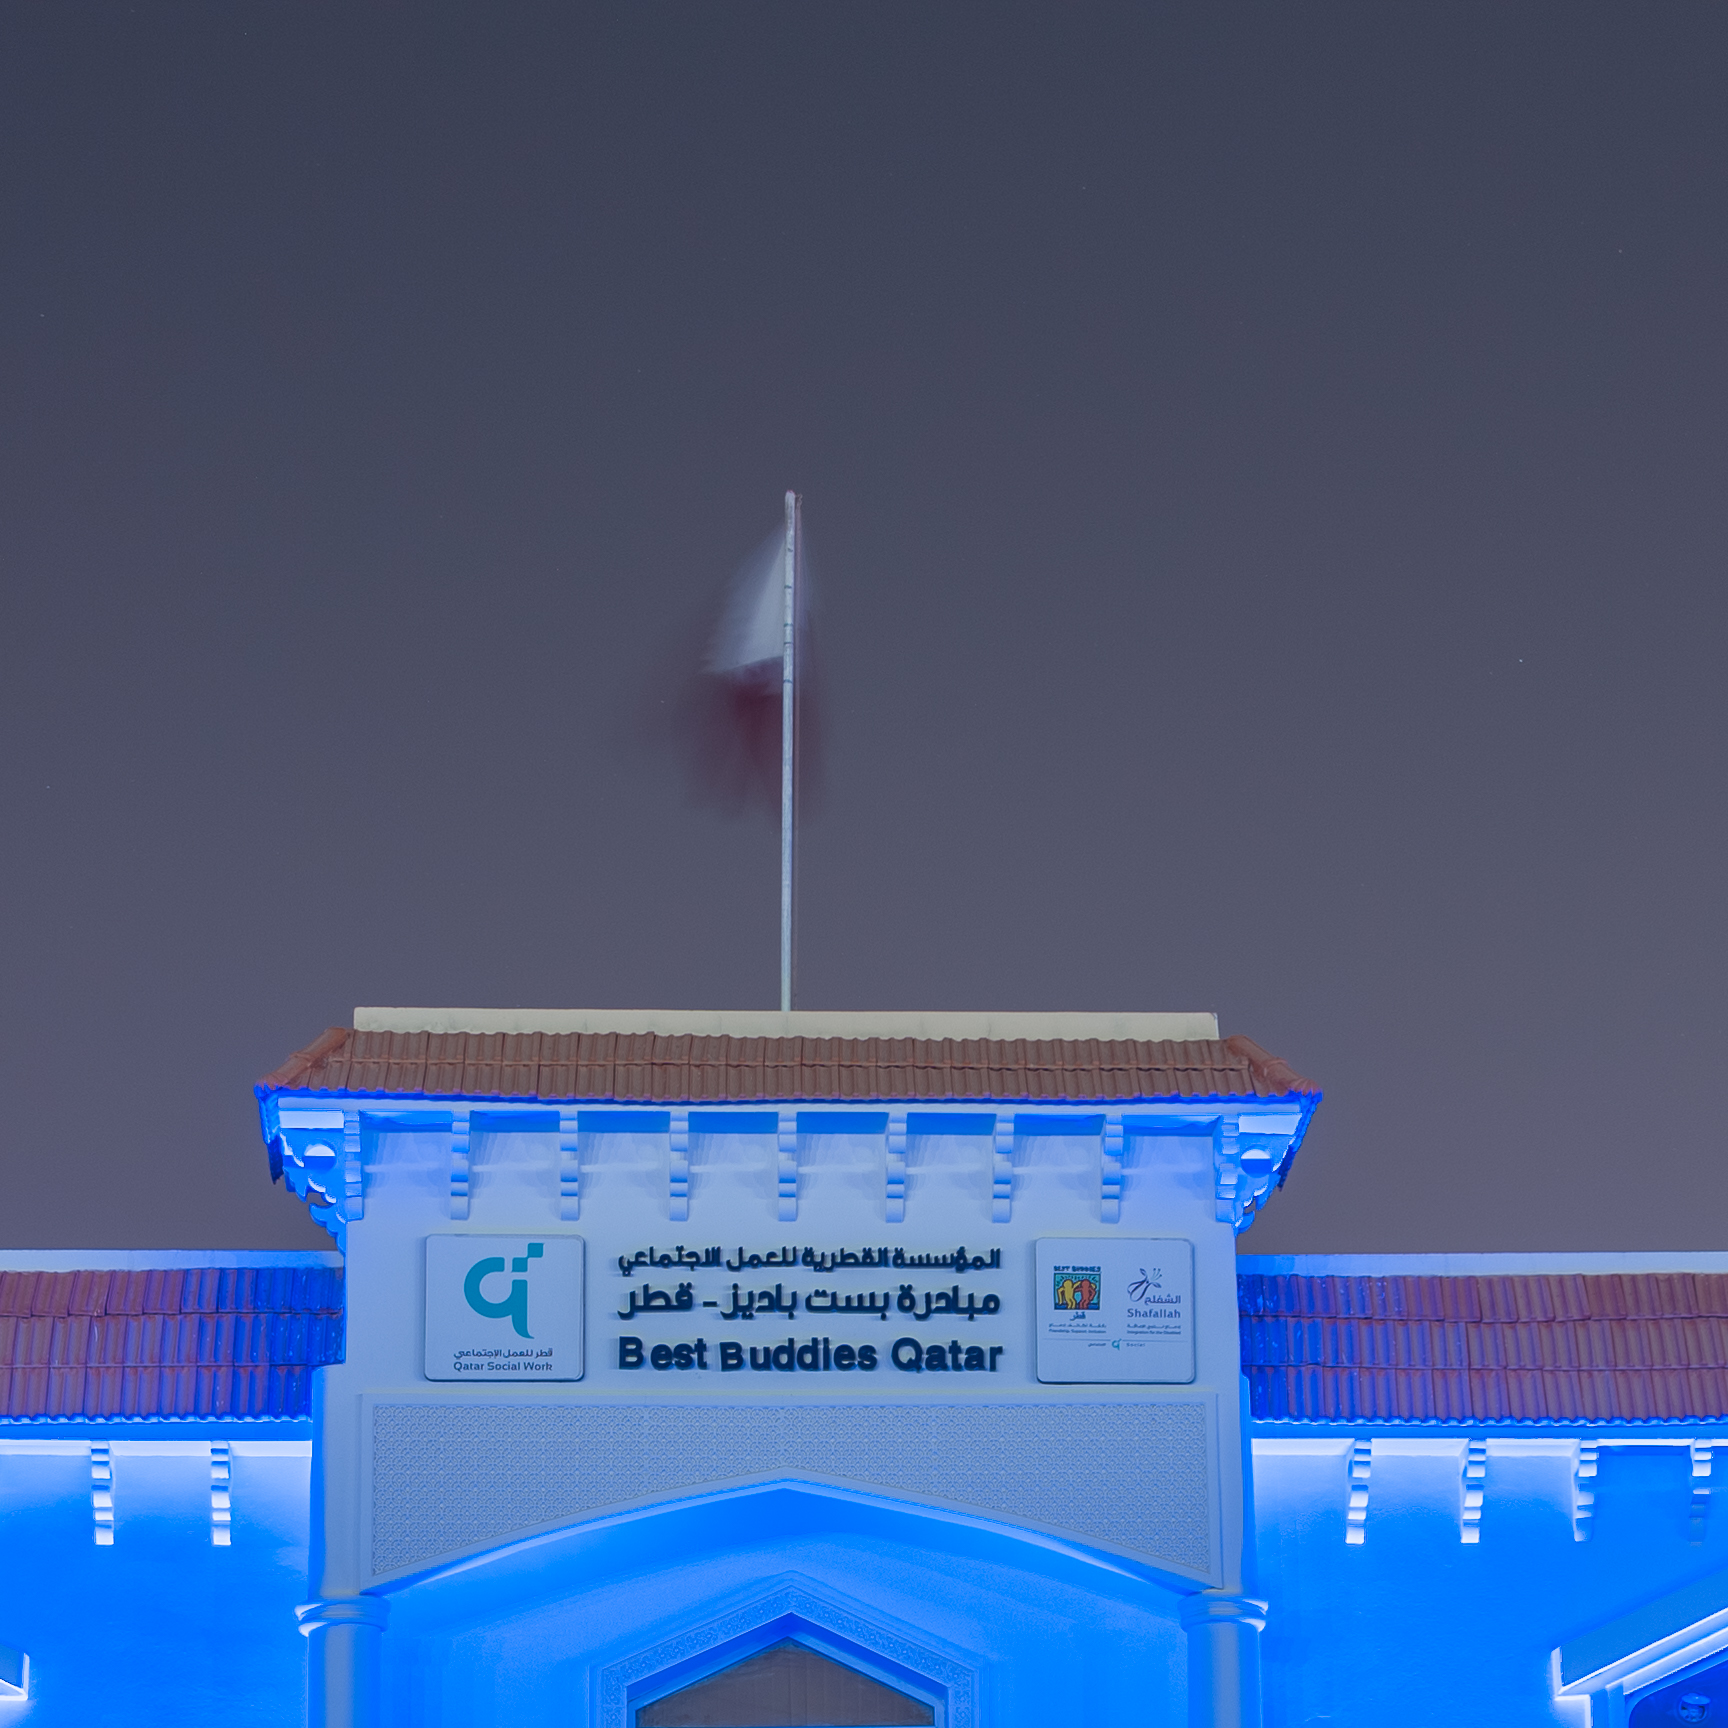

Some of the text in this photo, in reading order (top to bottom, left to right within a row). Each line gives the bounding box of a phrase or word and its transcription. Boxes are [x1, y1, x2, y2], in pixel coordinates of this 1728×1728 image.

[618, 1246, 1001, 1276] المؤسسة القطرية للعمل الاجتماعي
[617, 1282, 693, 1319] قطر
[720, 1283, 797, 1319] باديز
[805, 1288, 890, 1320] بست
[896, 1284, 1001, 1320] مبادرة
[1127, 1308, 1181, 1318] Shafallah
[453, 1361, 553, 1372] Qatar Social Work
[503, 1349, 533, 1358] للعمل
[534, 1348, 553, 1359] قطر
[618, 1336, 1003, 1373] Best Buddies Qatar
